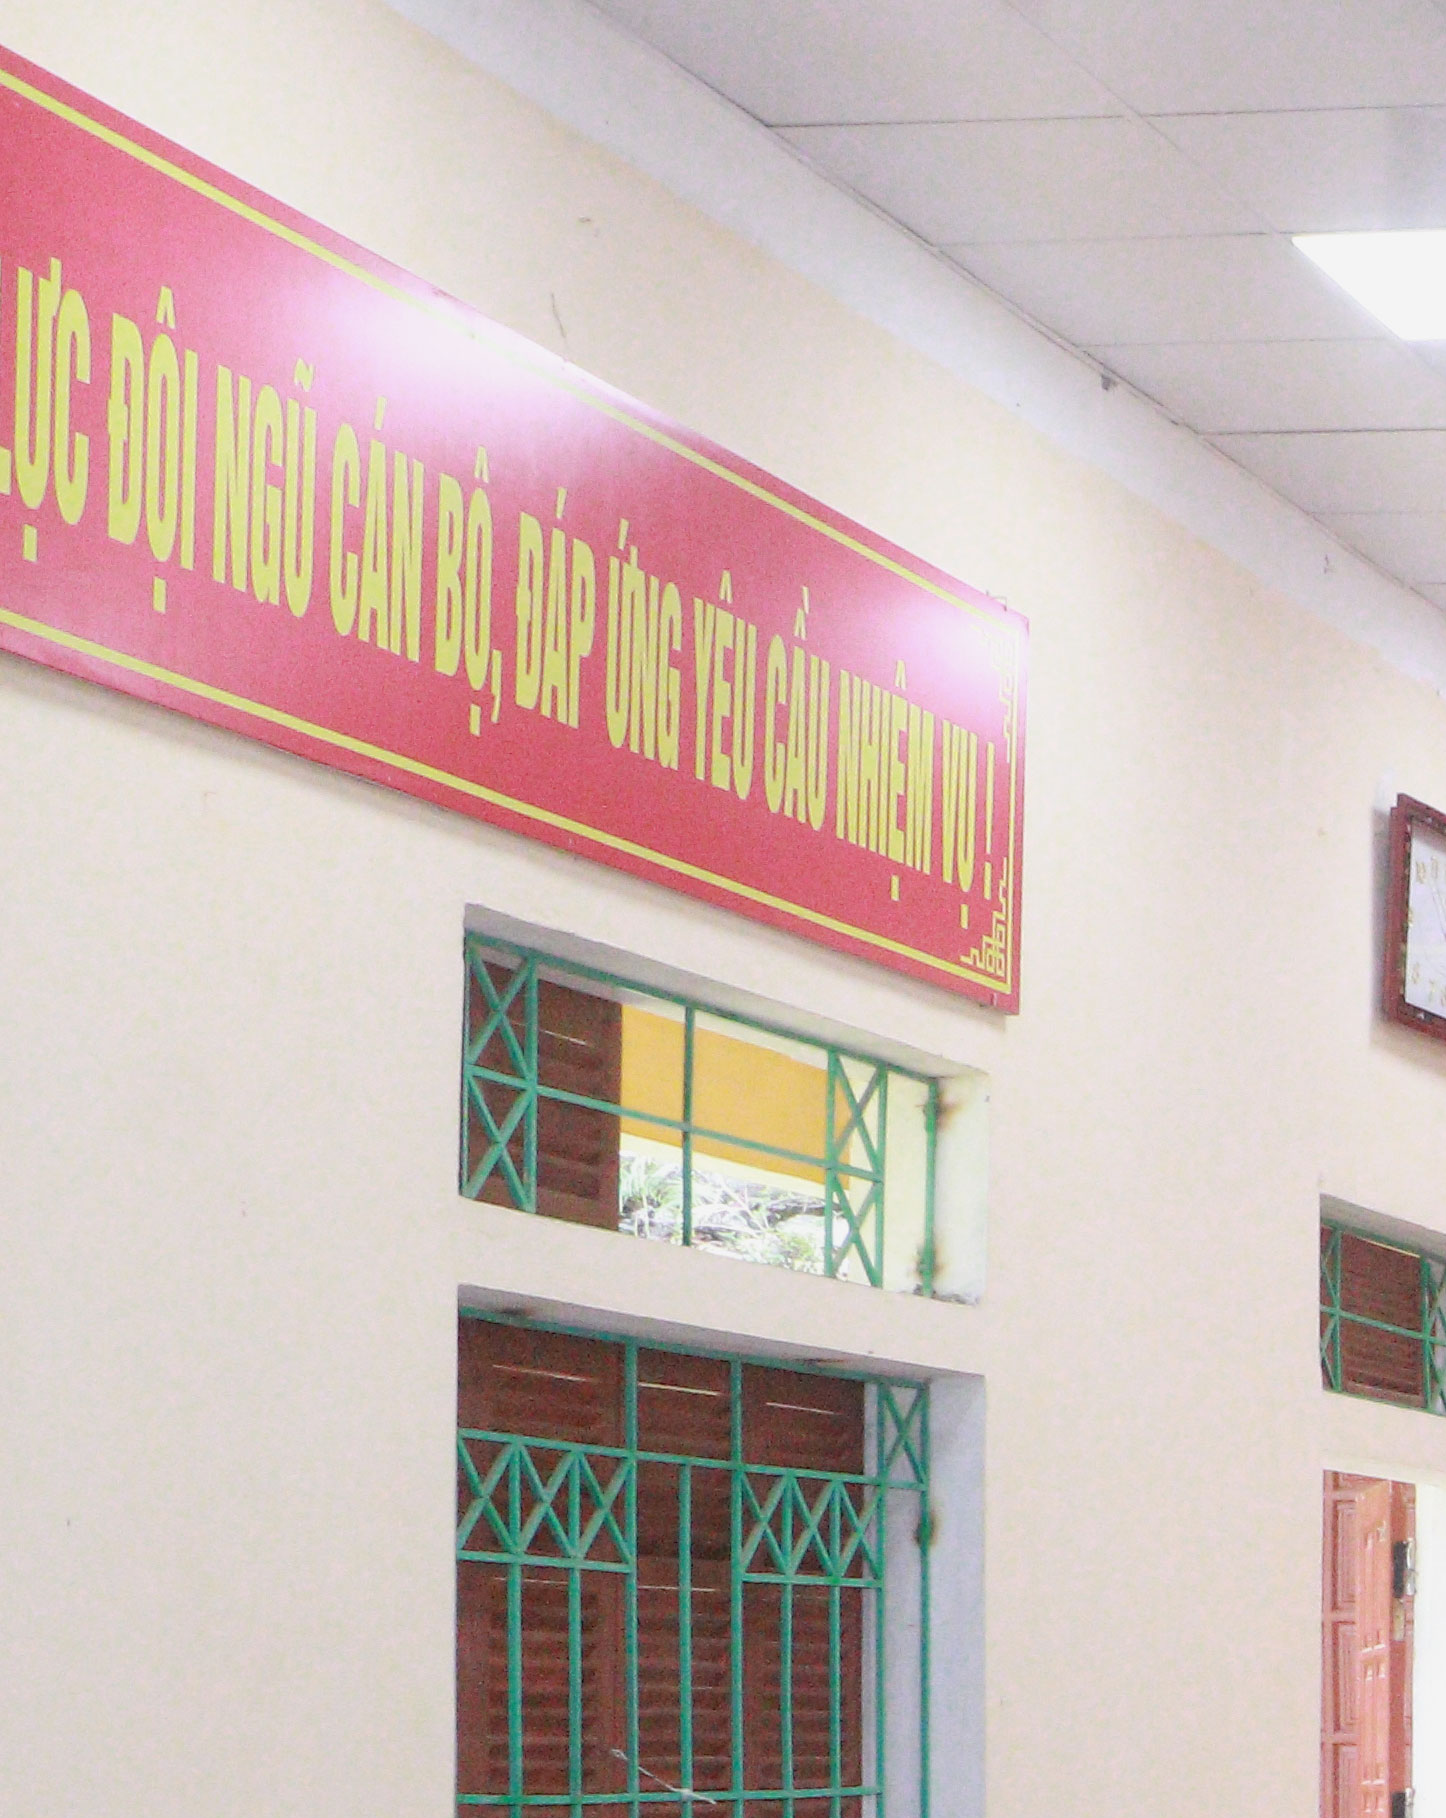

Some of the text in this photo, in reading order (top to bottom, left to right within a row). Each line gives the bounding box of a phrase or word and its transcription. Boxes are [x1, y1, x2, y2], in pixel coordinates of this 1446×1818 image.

[0, 258, 91, 562] ỰC
[108, 286, 198, 612] ĐỘI
[211, 360, 317, 617] NGŨ
[331, 398, 425, 662] CÁN
[436, 447, 501, 734] BỘ,
[515, 488, 595, 727] ĐÁP
[607, 520, 685, 771] ỨNG
[693, 571, 758, 799] YÊU
[764, 587, 830, 830] CẦU
[837, 660, 936, 900] NHIỆM
[940, 718, 979, 928] VỤ
